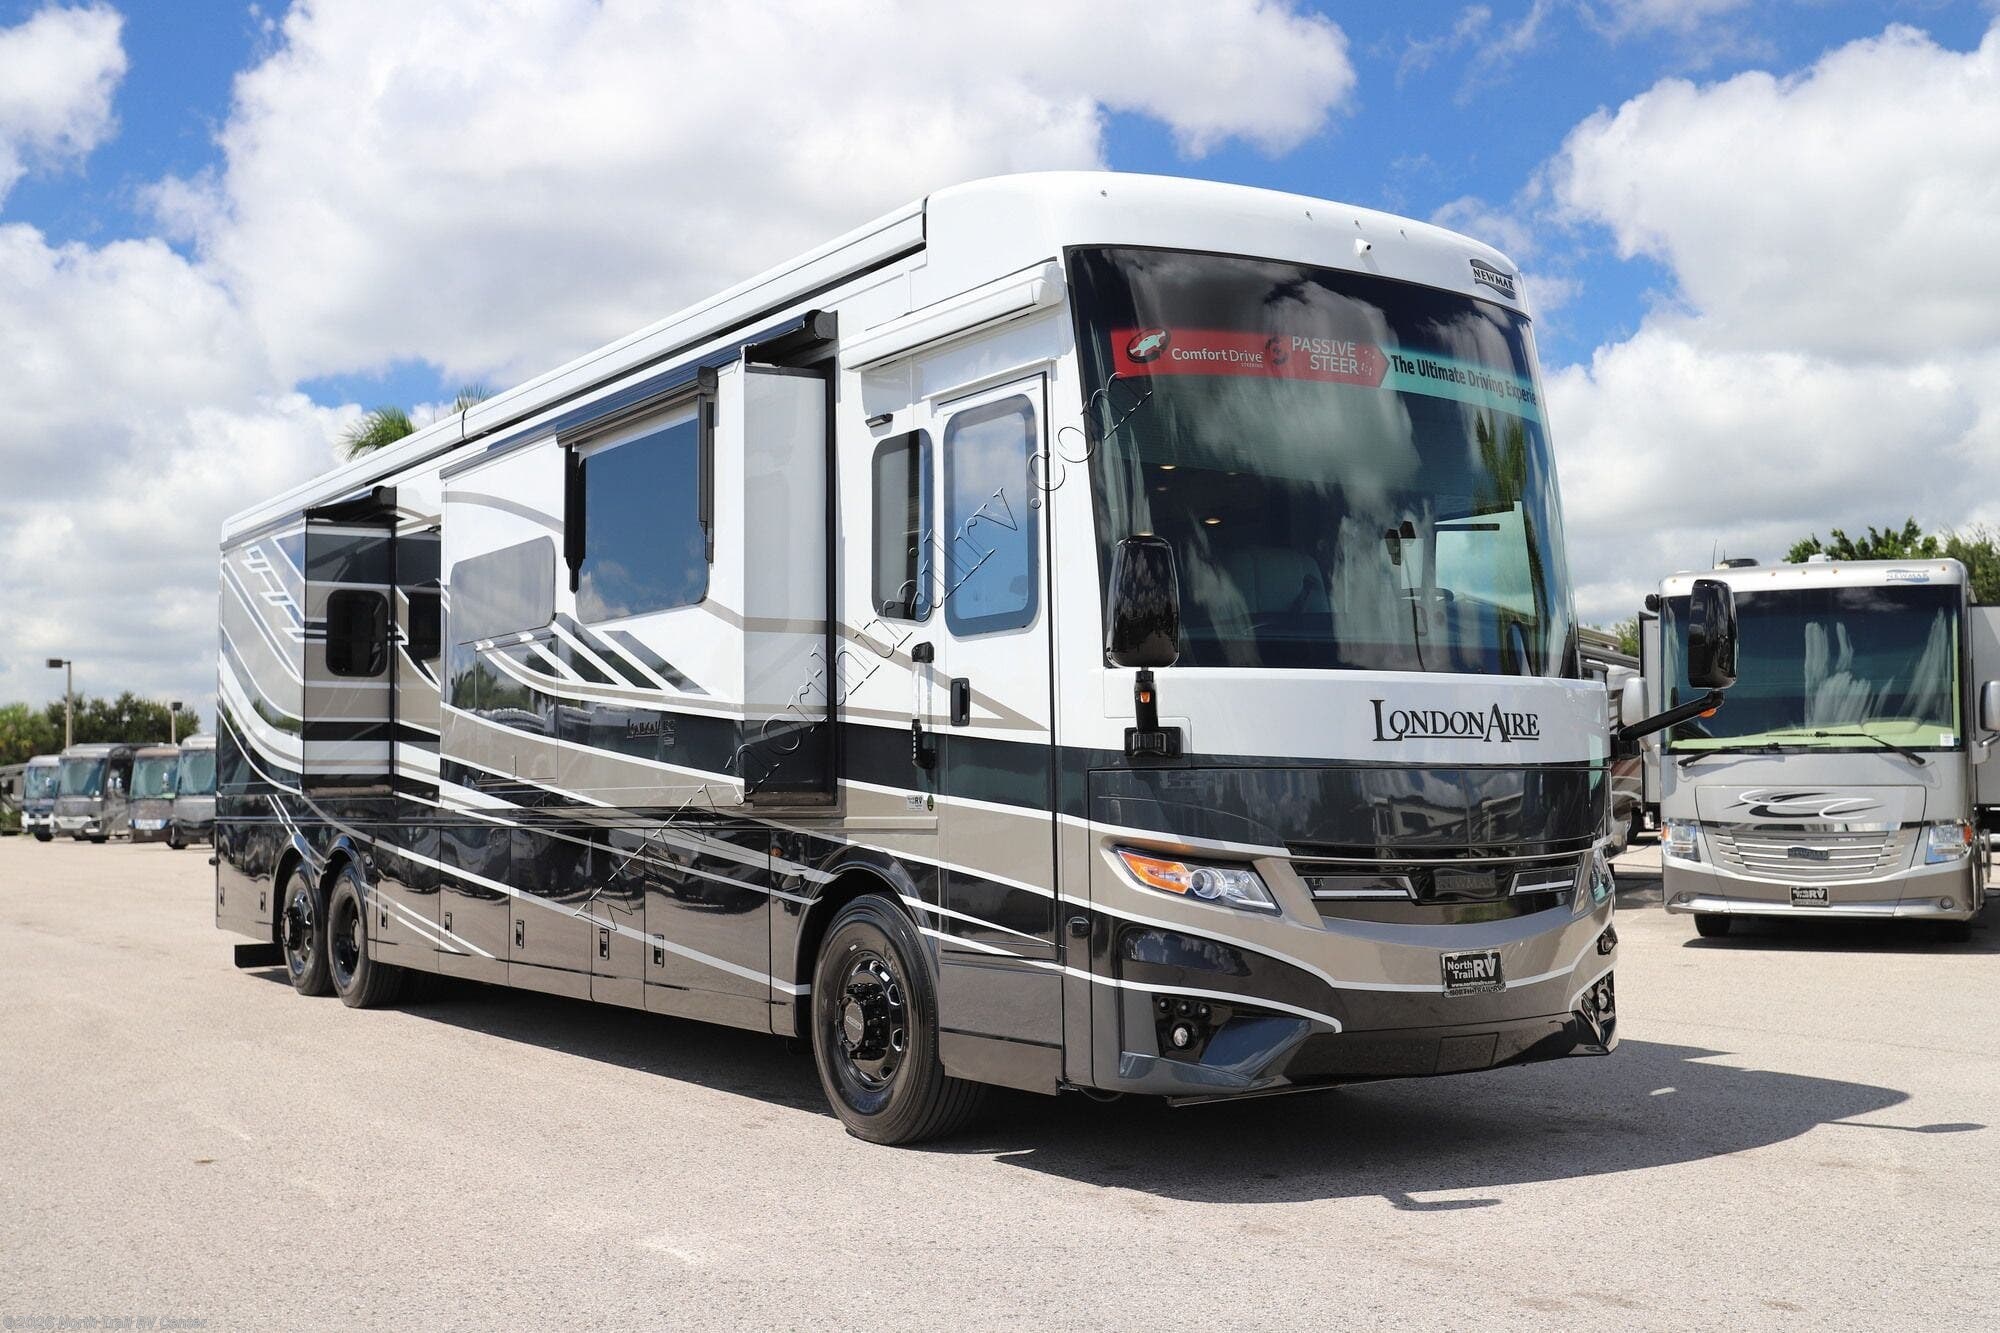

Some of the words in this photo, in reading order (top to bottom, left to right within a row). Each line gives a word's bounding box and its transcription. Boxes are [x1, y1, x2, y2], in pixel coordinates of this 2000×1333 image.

[1171, 347, 1228, 361] Comfort
[1229, 349, 1263, 363] Drive
[1292, 336, 1357, 358] PASSIVE
[1310, 354, 1360, 375] STEER
[1391, 354, 1415, 375] The
[1417, 359, 1467, 385] Ultimate
[1468, 369, 1504, 398] Driving
[1447, 961, 1473, 971] North
[1453, 970, 1474, 979] Trail
[1473, 958, 1497, 978] RV
